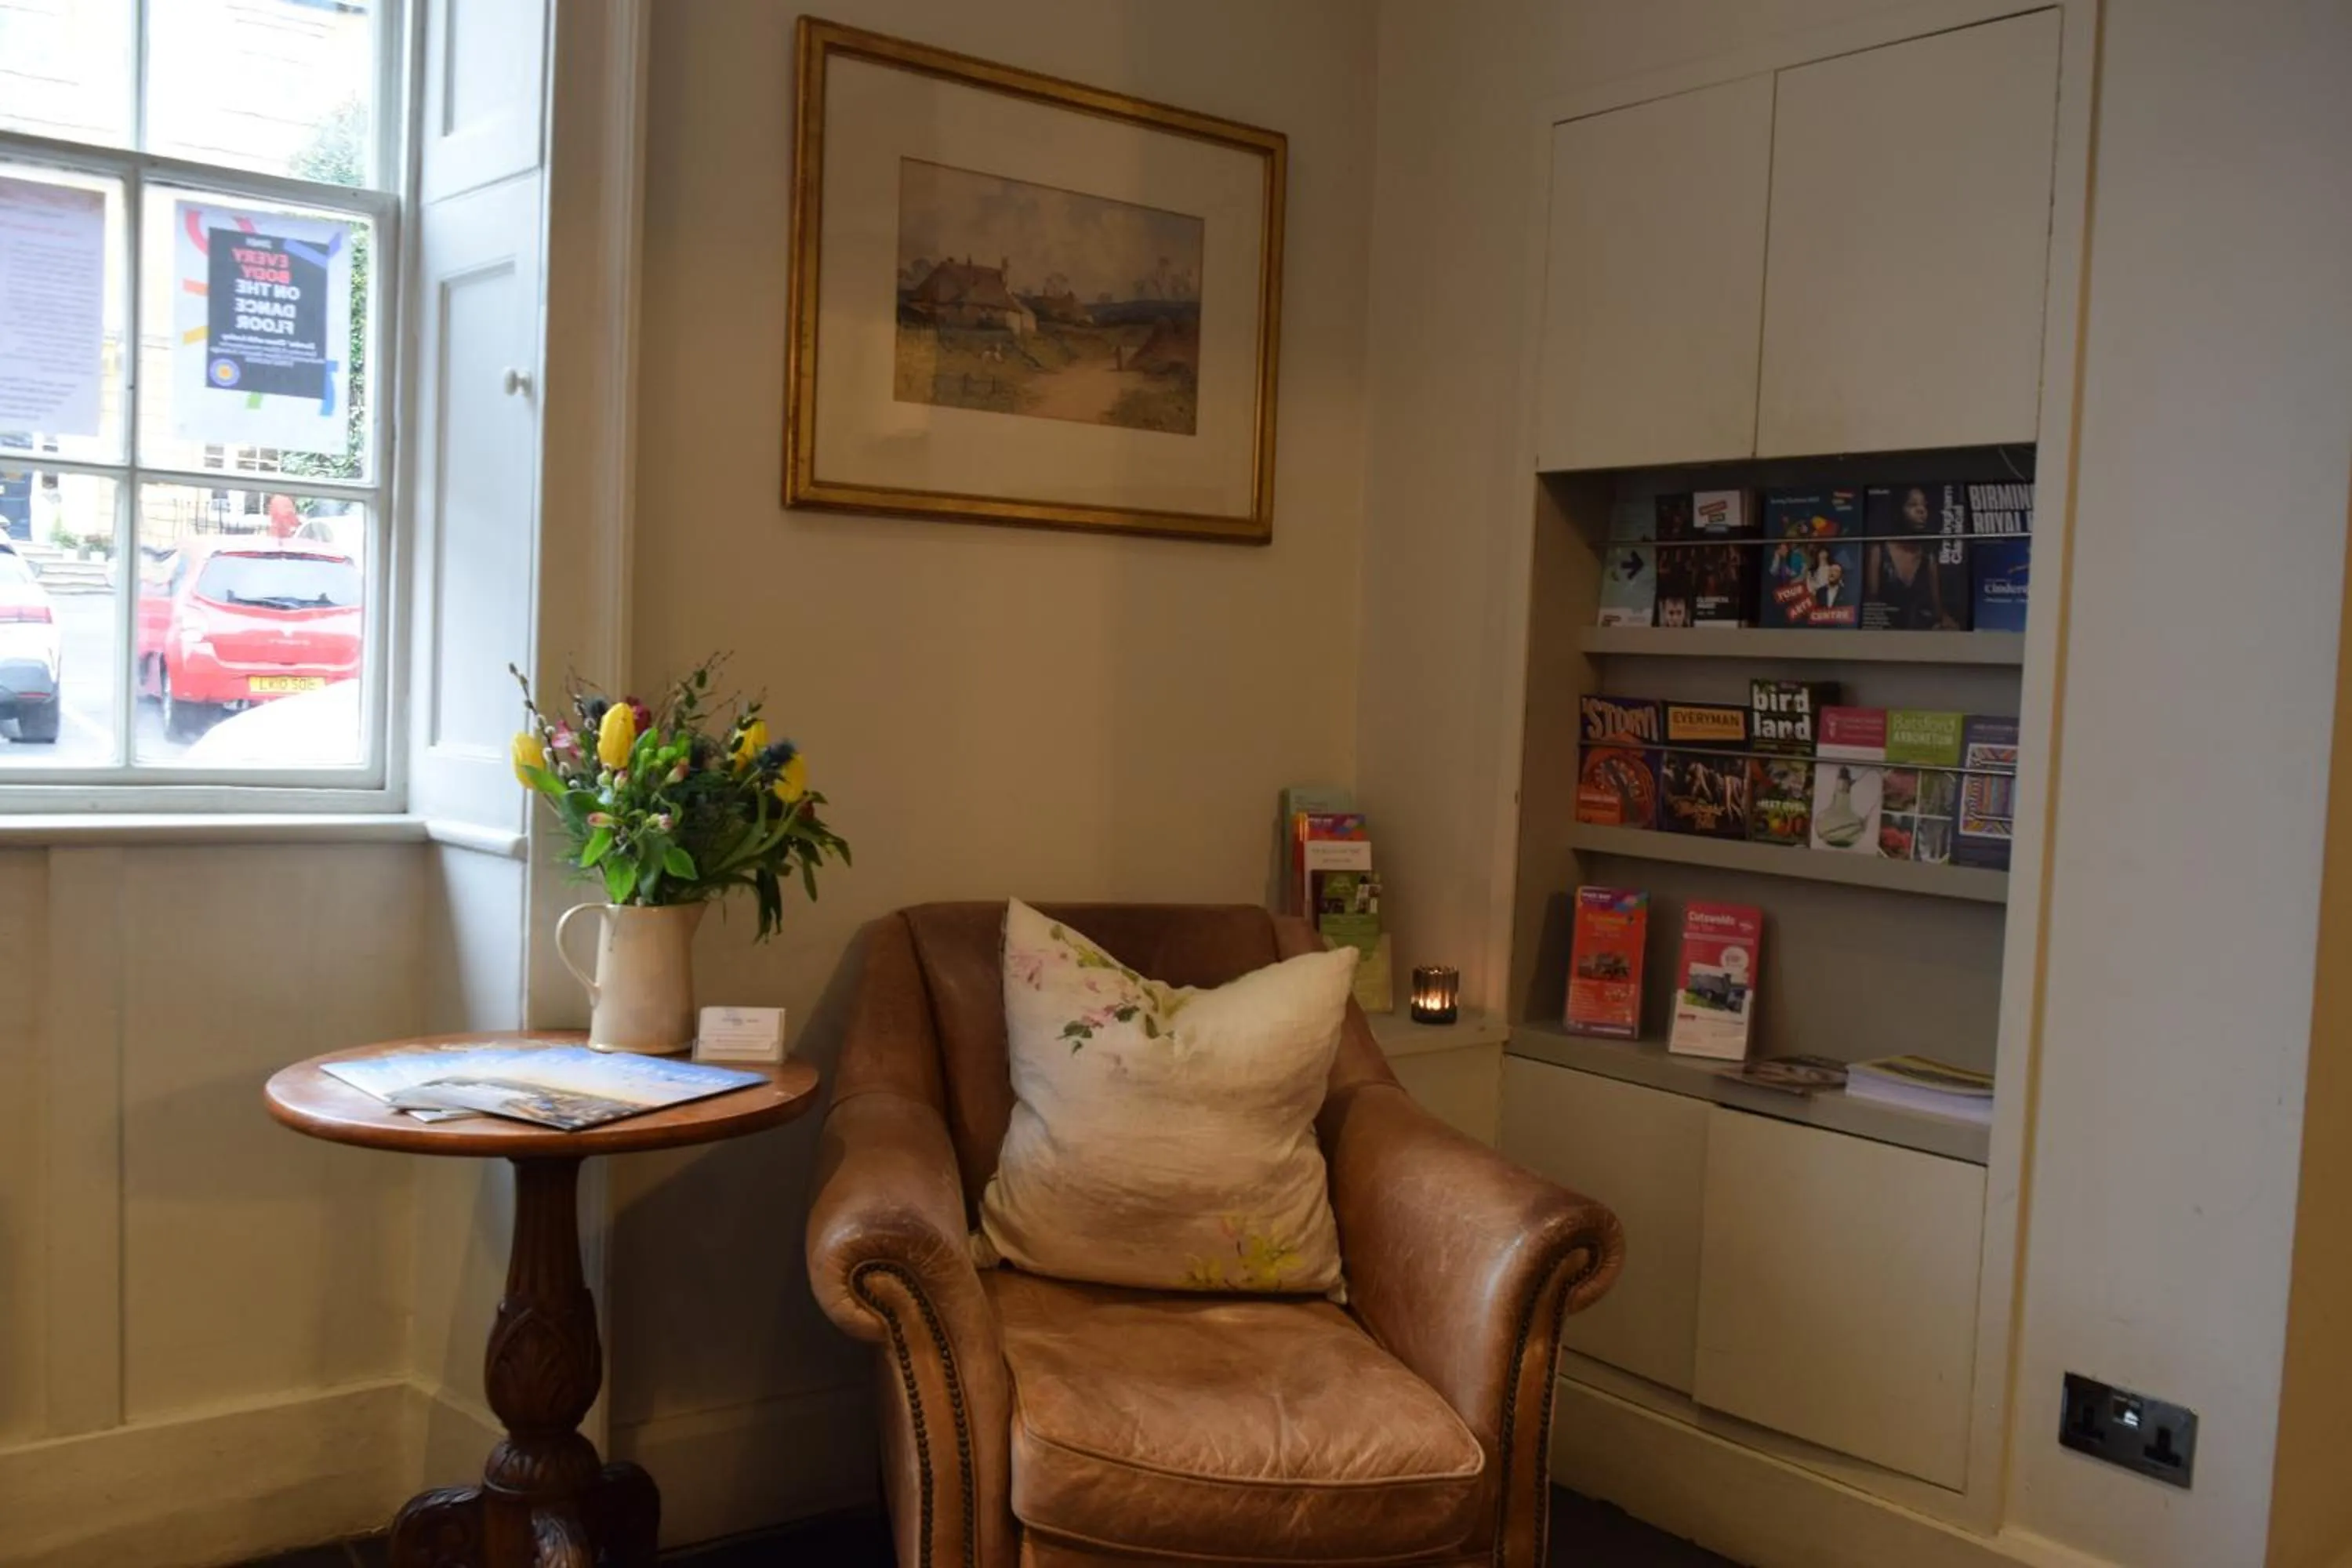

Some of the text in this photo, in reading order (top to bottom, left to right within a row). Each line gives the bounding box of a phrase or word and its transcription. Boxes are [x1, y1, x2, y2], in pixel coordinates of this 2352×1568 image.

[1973, 511, 2021, 535] ROYAL
[1752, 684, 1810, 713] bird
[1672, 710, 1740, 728] EVERYMAN
[1753, 711, 1812, 741] land
